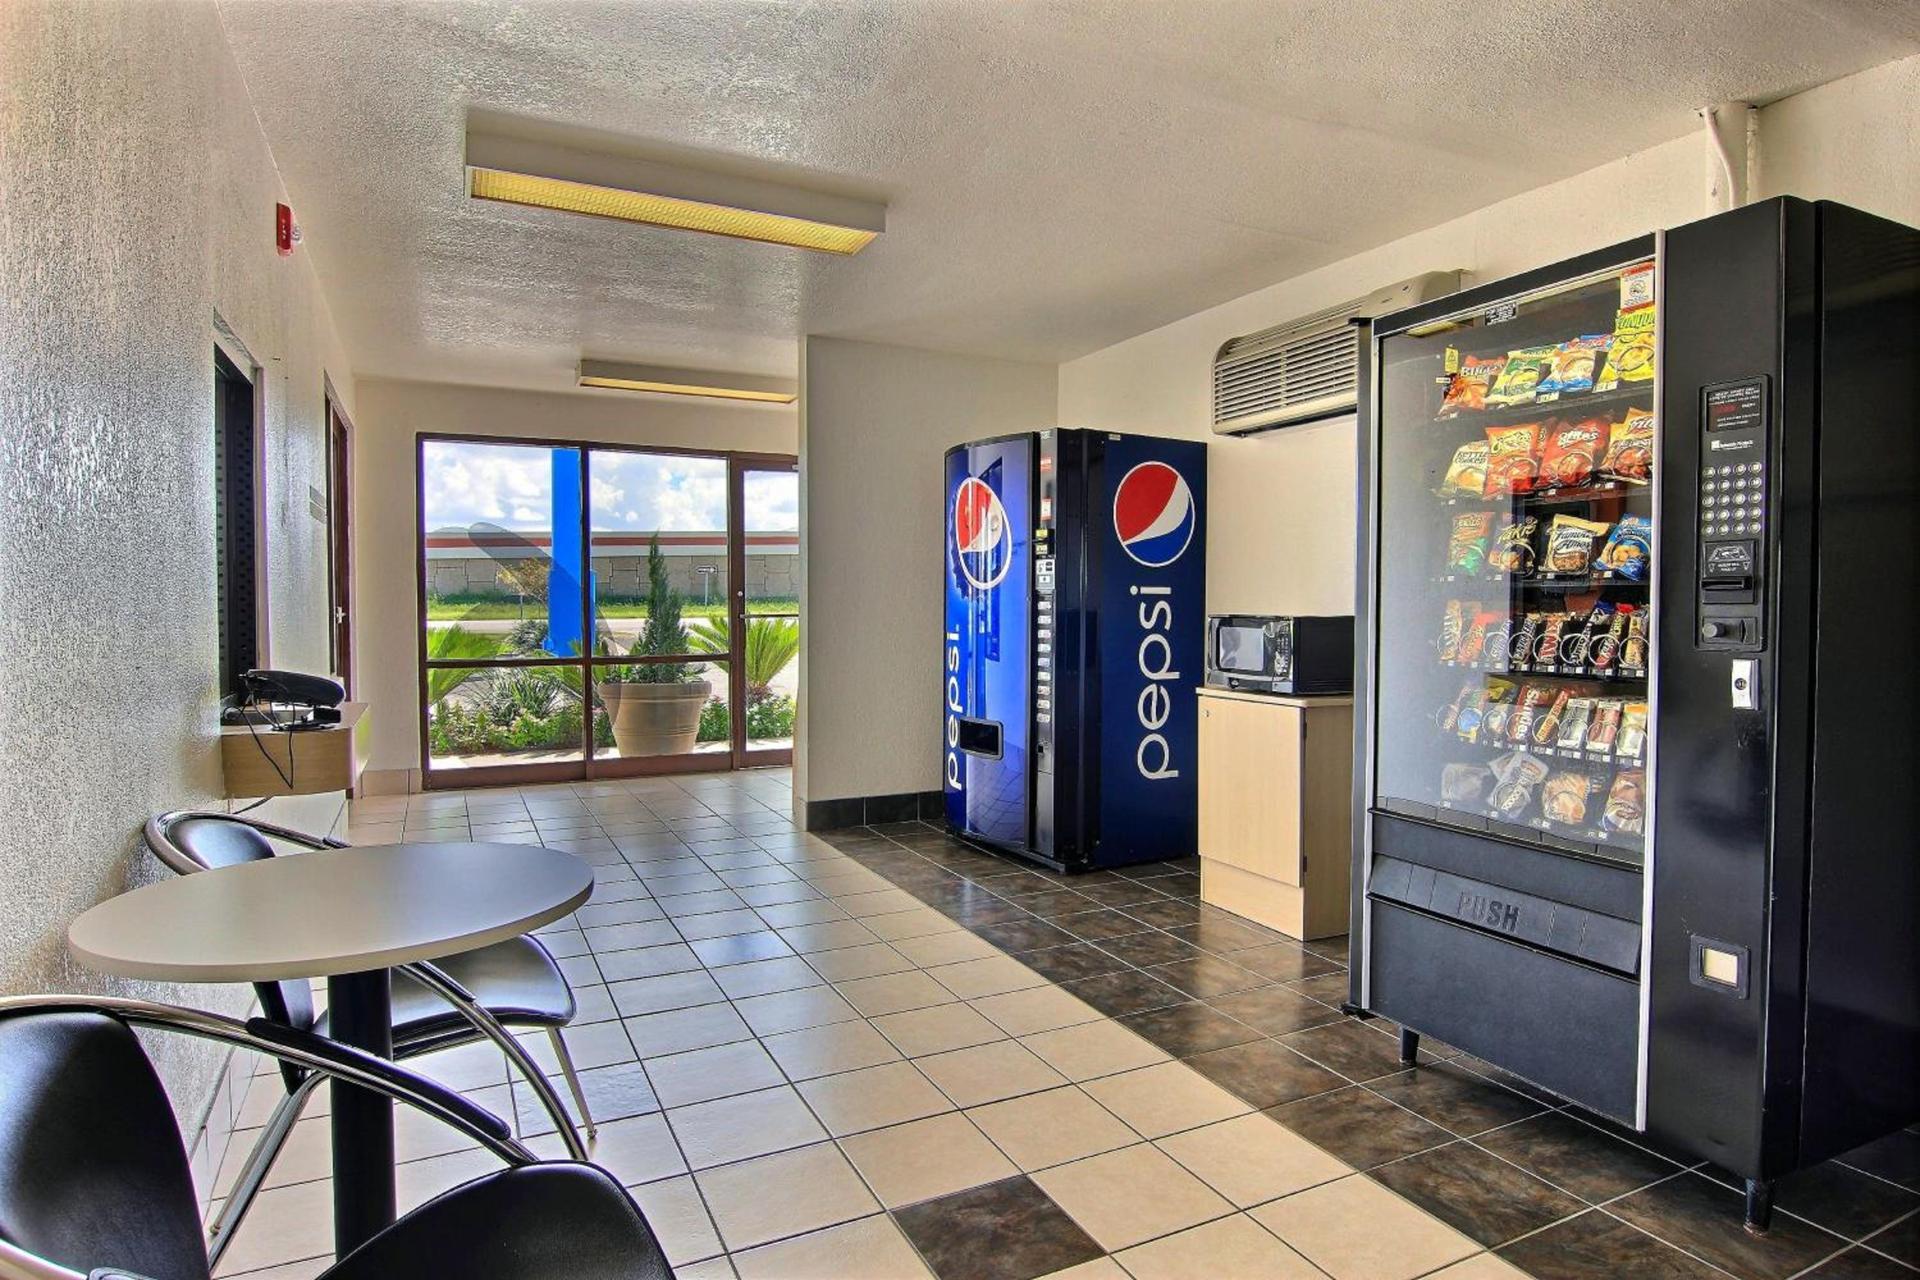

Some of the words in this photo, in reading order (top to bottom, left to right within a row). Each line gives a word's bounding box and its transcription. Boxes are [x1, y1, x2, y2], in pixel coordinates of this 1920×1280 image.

[946, 624, 963, 791] pepsi
[1129, 585, 1180, 780] pepsi
[1458, 891, 1519, 932] PUSH
